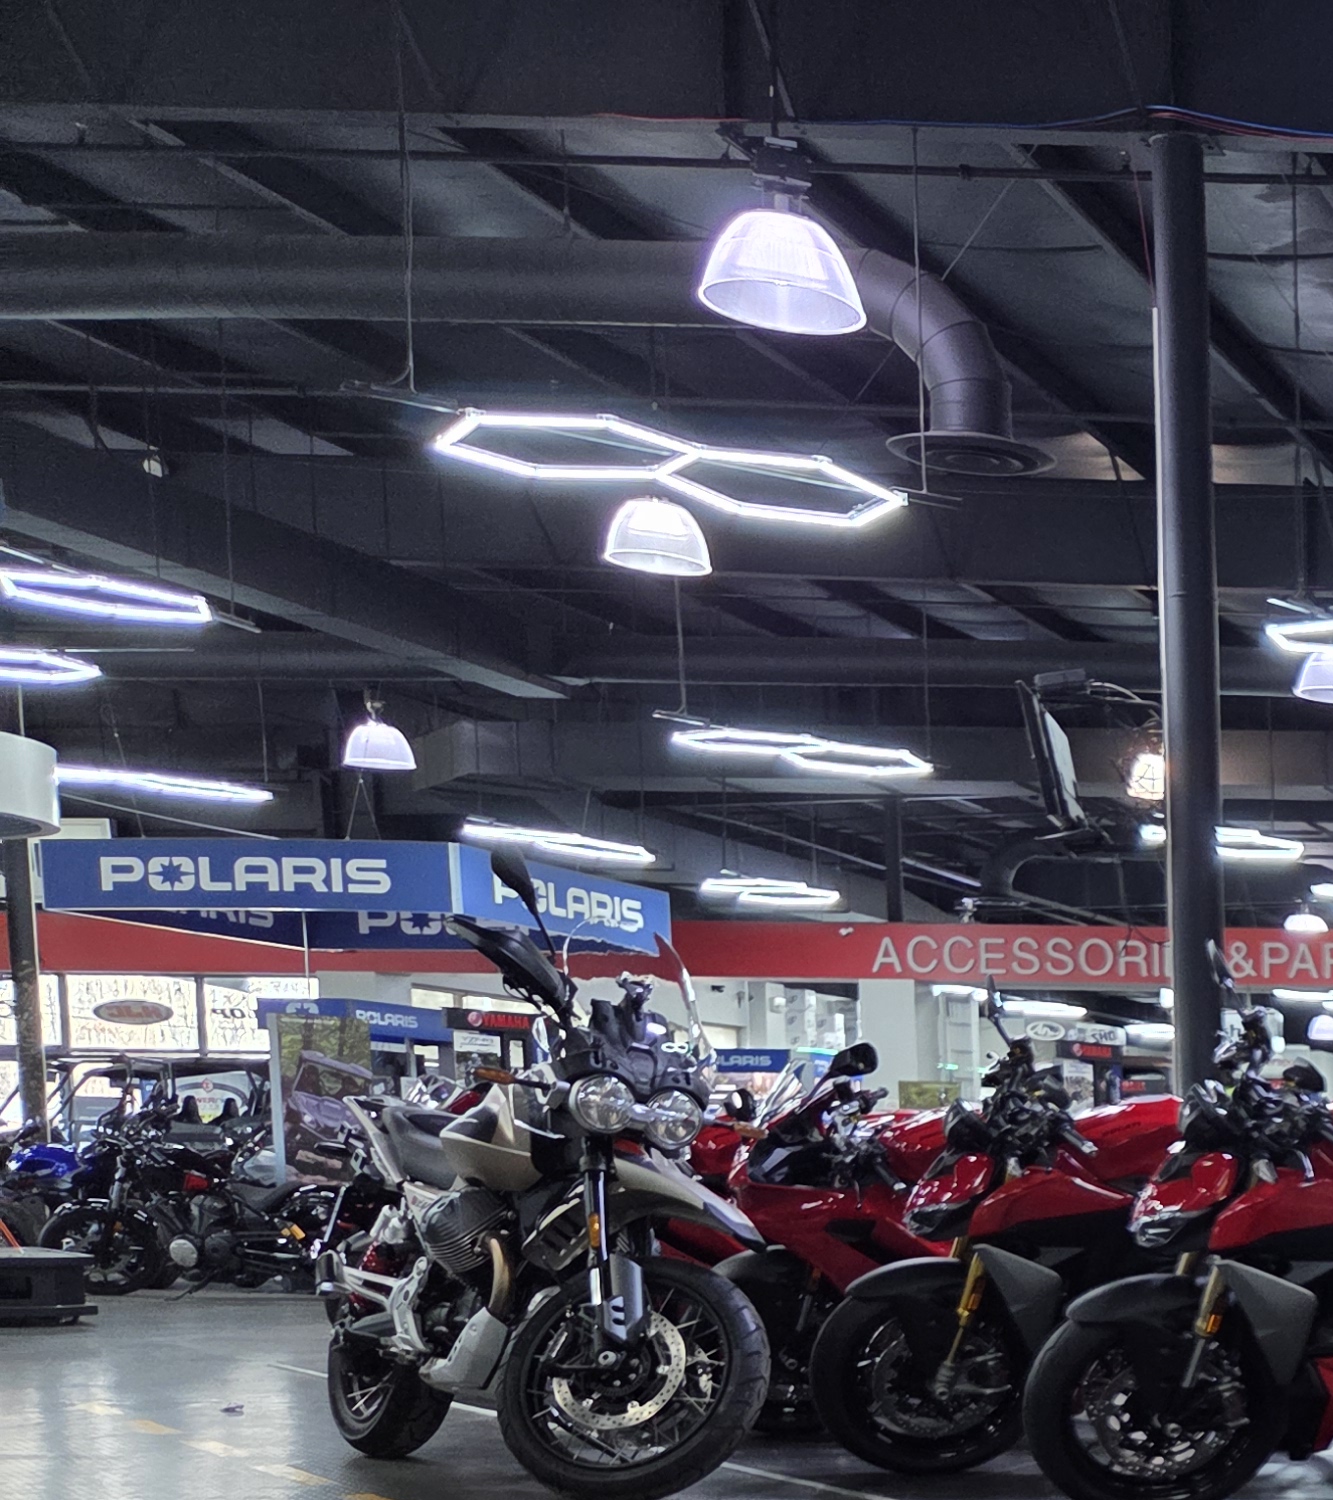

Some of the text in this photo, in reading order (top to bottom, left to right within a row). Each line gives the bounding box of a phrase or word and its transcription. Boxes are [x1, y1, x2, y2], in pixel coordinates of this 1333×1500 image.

[100, 856, 392, 894] POLARIS
[872, 935, 1171, 977] ACCESSORI
[717, 1055, 772, 1067] LARIS
